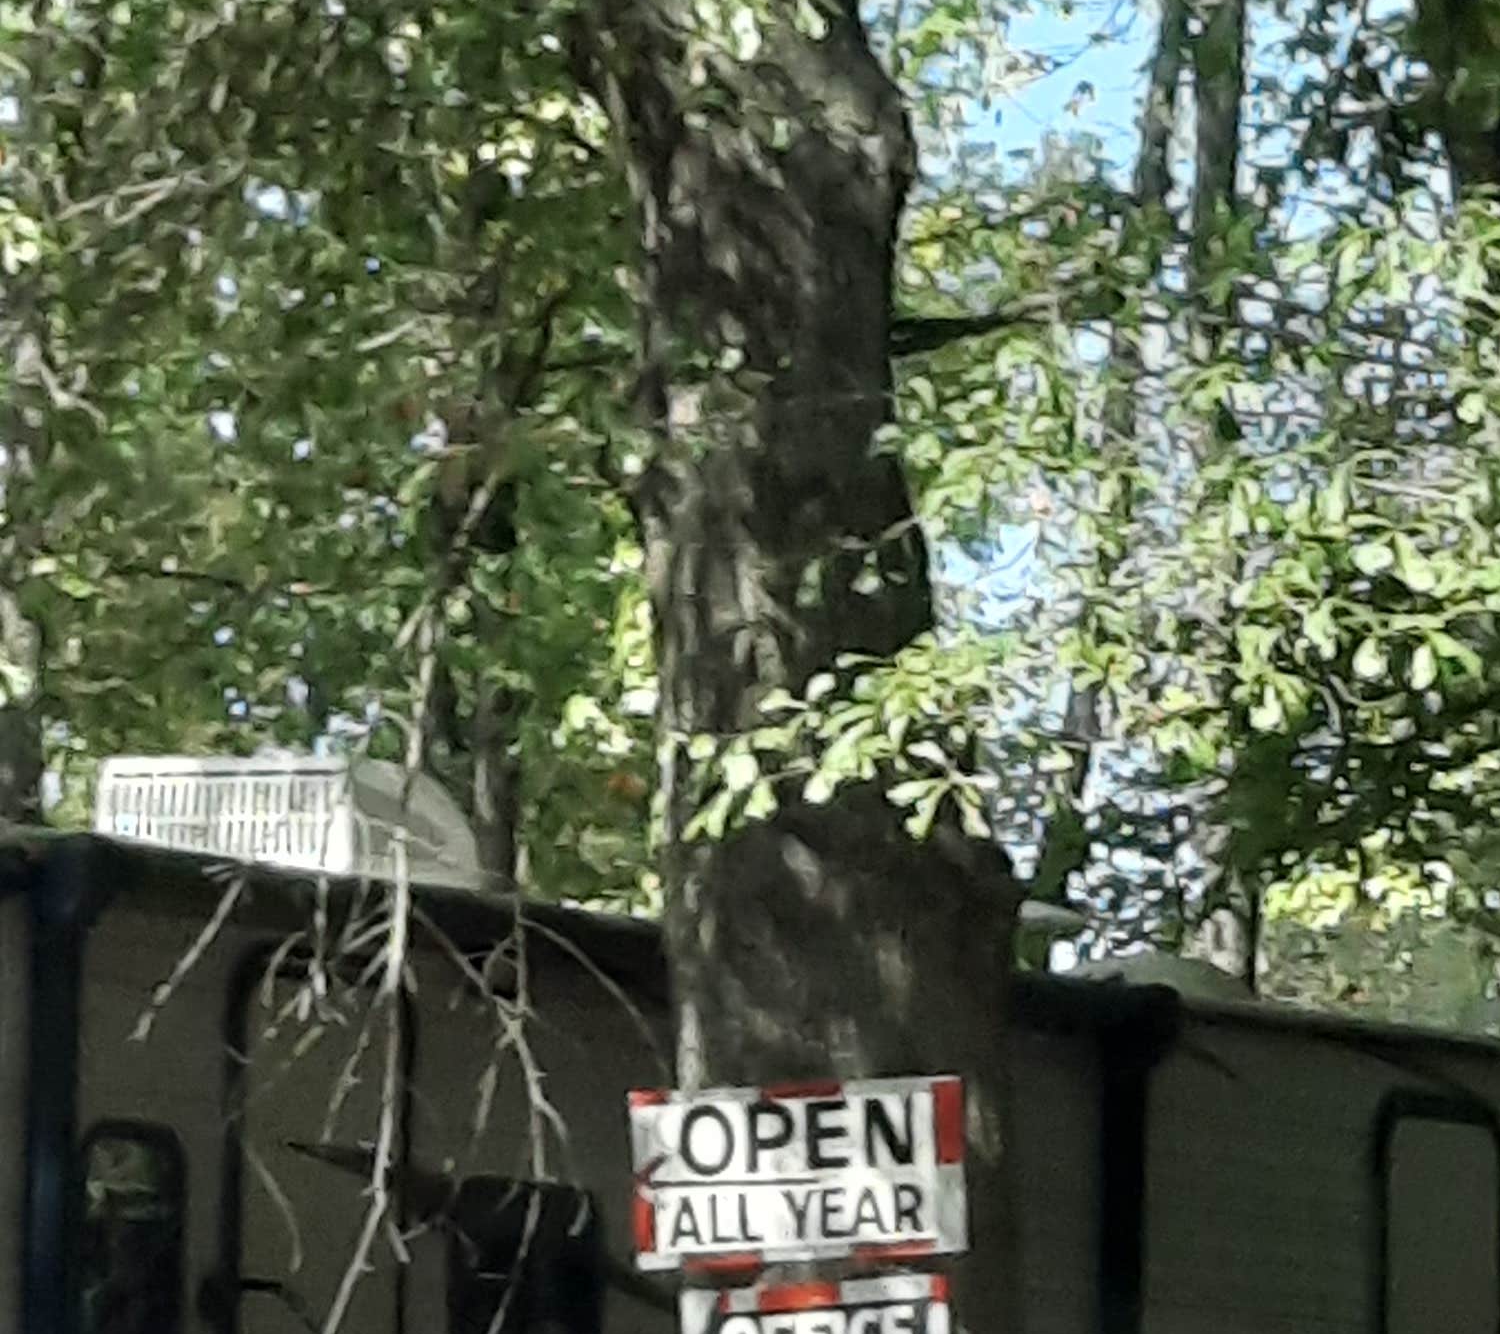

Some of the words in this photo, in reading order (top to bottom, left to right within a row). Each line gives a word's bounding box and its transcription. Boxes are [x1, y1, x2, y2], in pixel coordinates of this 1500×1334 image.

[680, 1097, 915, 1176] OPEN
[670, 1193, 764, 1247] ALL
[782, 1183, 925, 1240] YEAR
